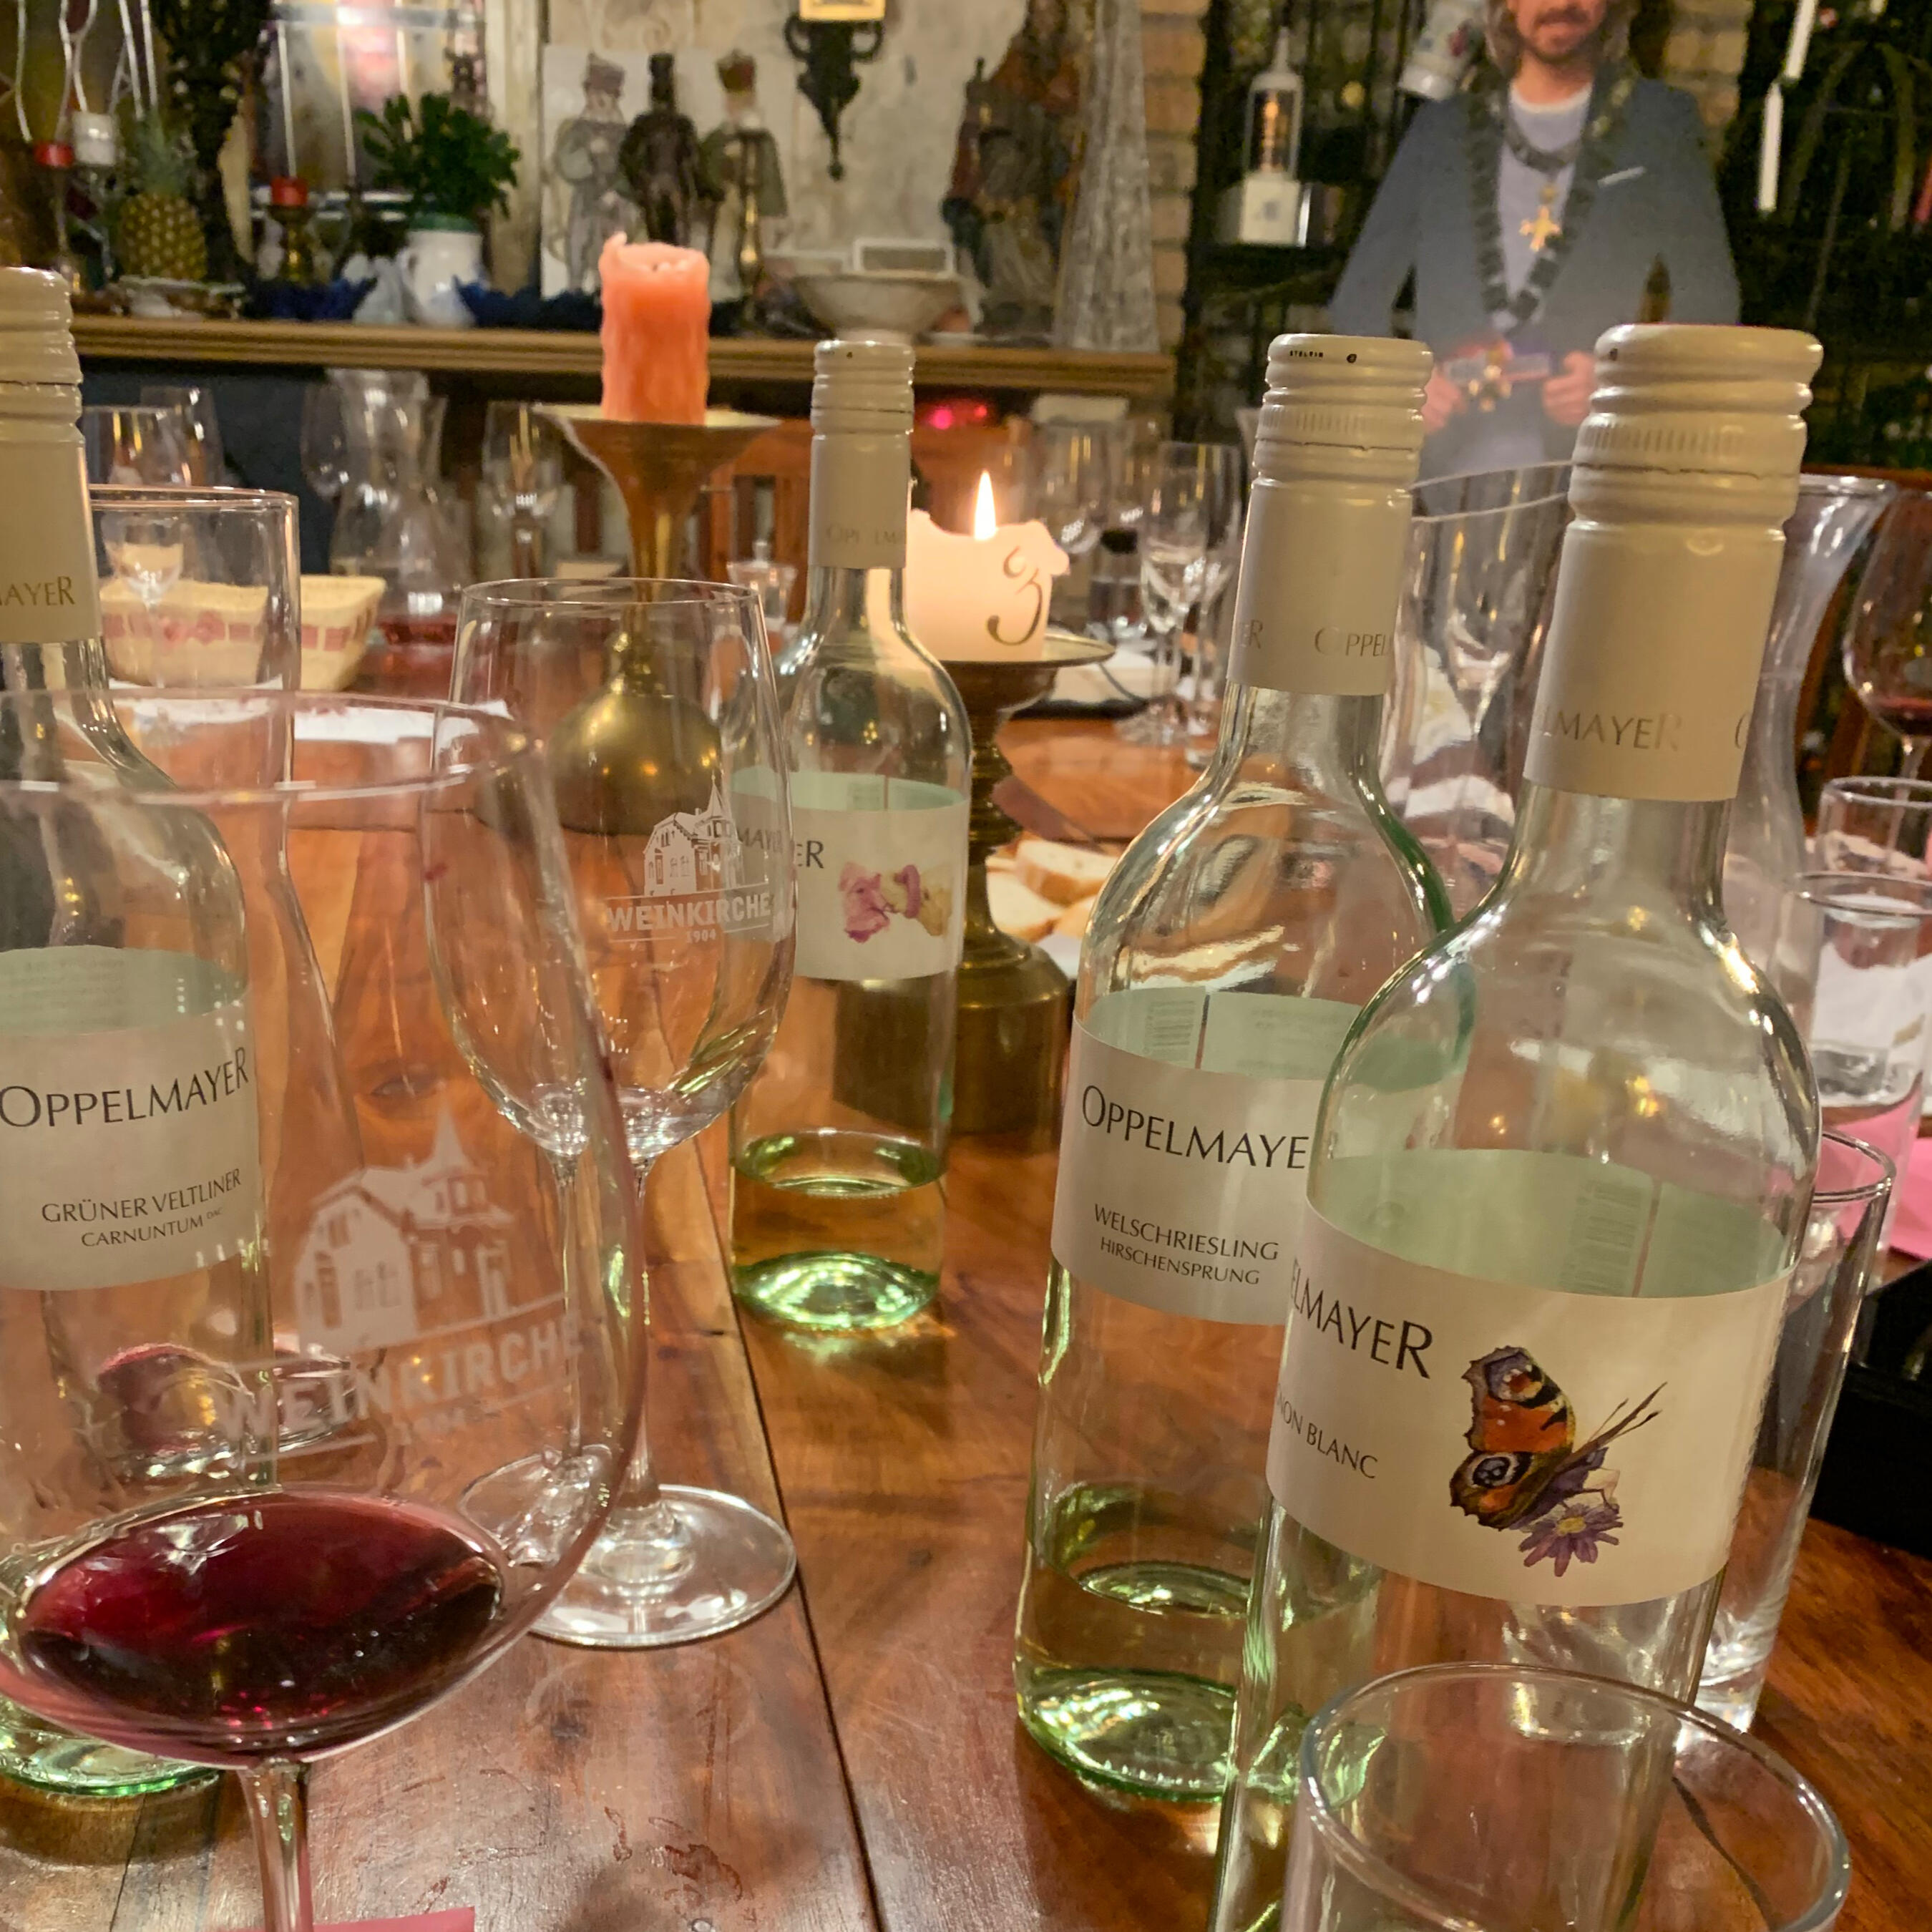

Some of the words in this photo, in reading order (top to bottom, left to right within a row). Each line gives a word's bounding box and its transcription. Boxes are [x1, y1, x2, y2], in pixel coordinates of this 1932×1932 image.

[0, 575, 75, 607] AYER
[606, 892, 772, 932] WEINKIRCHE
[0, 1046, 249, 1128] OPPELMAYER
[42, 1198, 149, 1224] GRÜNER
[152, 1168, 242, 1213] VELTLINER
[81, 1214, 204, 1247] CARNUNTUM
[1094, 1203, 1279, 1261] WELSCHRIESLING
[1101, 1236, 1260, 1285] HIRSCHENSPRUNG
[1307, 1422, 1379, 1480] BLANC
